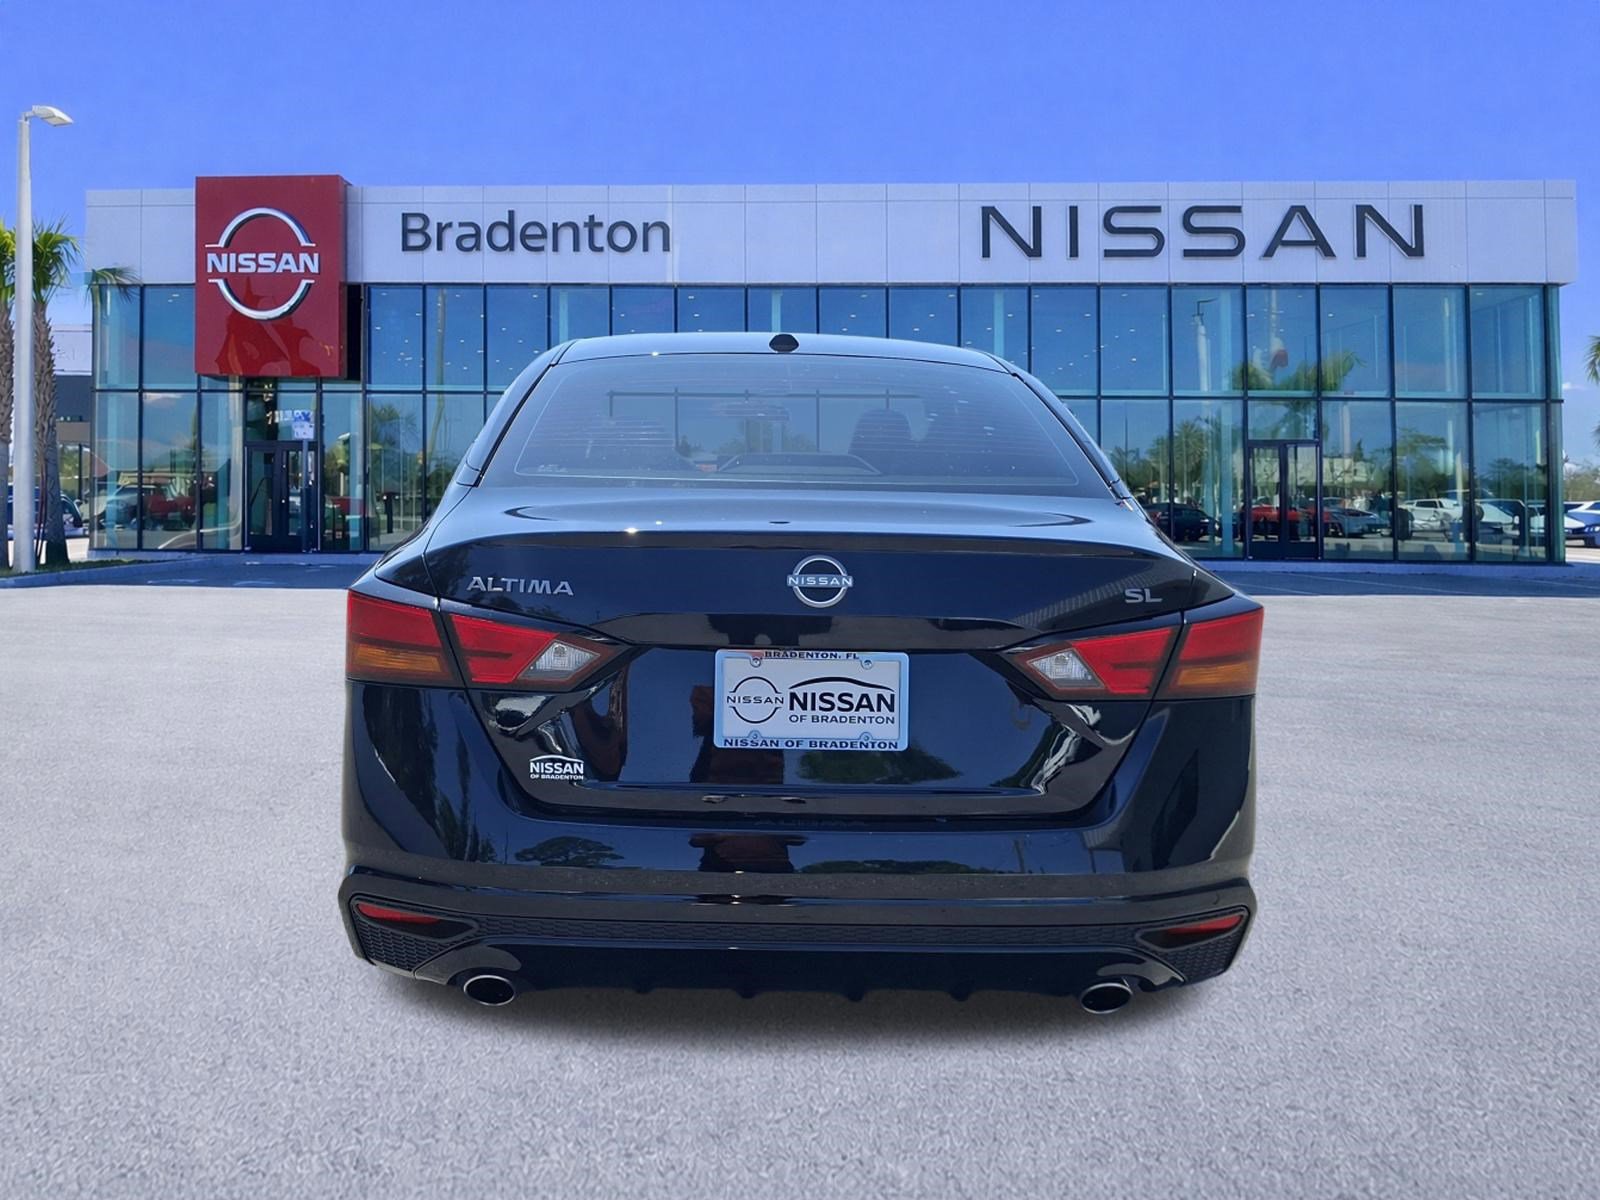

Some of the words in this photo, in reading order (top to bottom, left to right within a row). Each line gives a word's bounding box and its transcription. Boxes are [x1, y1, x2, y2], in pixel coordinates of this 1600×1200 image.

[401, 210, 670, 252] Bradenton
[980, 204, 1424, 258] NISSAN
[206, 252, 319, 273] NISSAN
[466, 576, 574, 596] ALTIMA
[788, 576, 852, 586] NISSAN
[1125, 588, 1162, 603] SL
[727, 696, 784, 704] NISSAN
[789, 692, 895, 712] NISSAN
[789, 714, 806, 722] OF
[812, 715, 895, 724] BRADENTON
[724, 739, 779, 747] NISSAN
[785, 740, 803, 748] OF
[809, 741, 898, 749] BRADENTON
[530, 762, 584, 774] NISSAN
